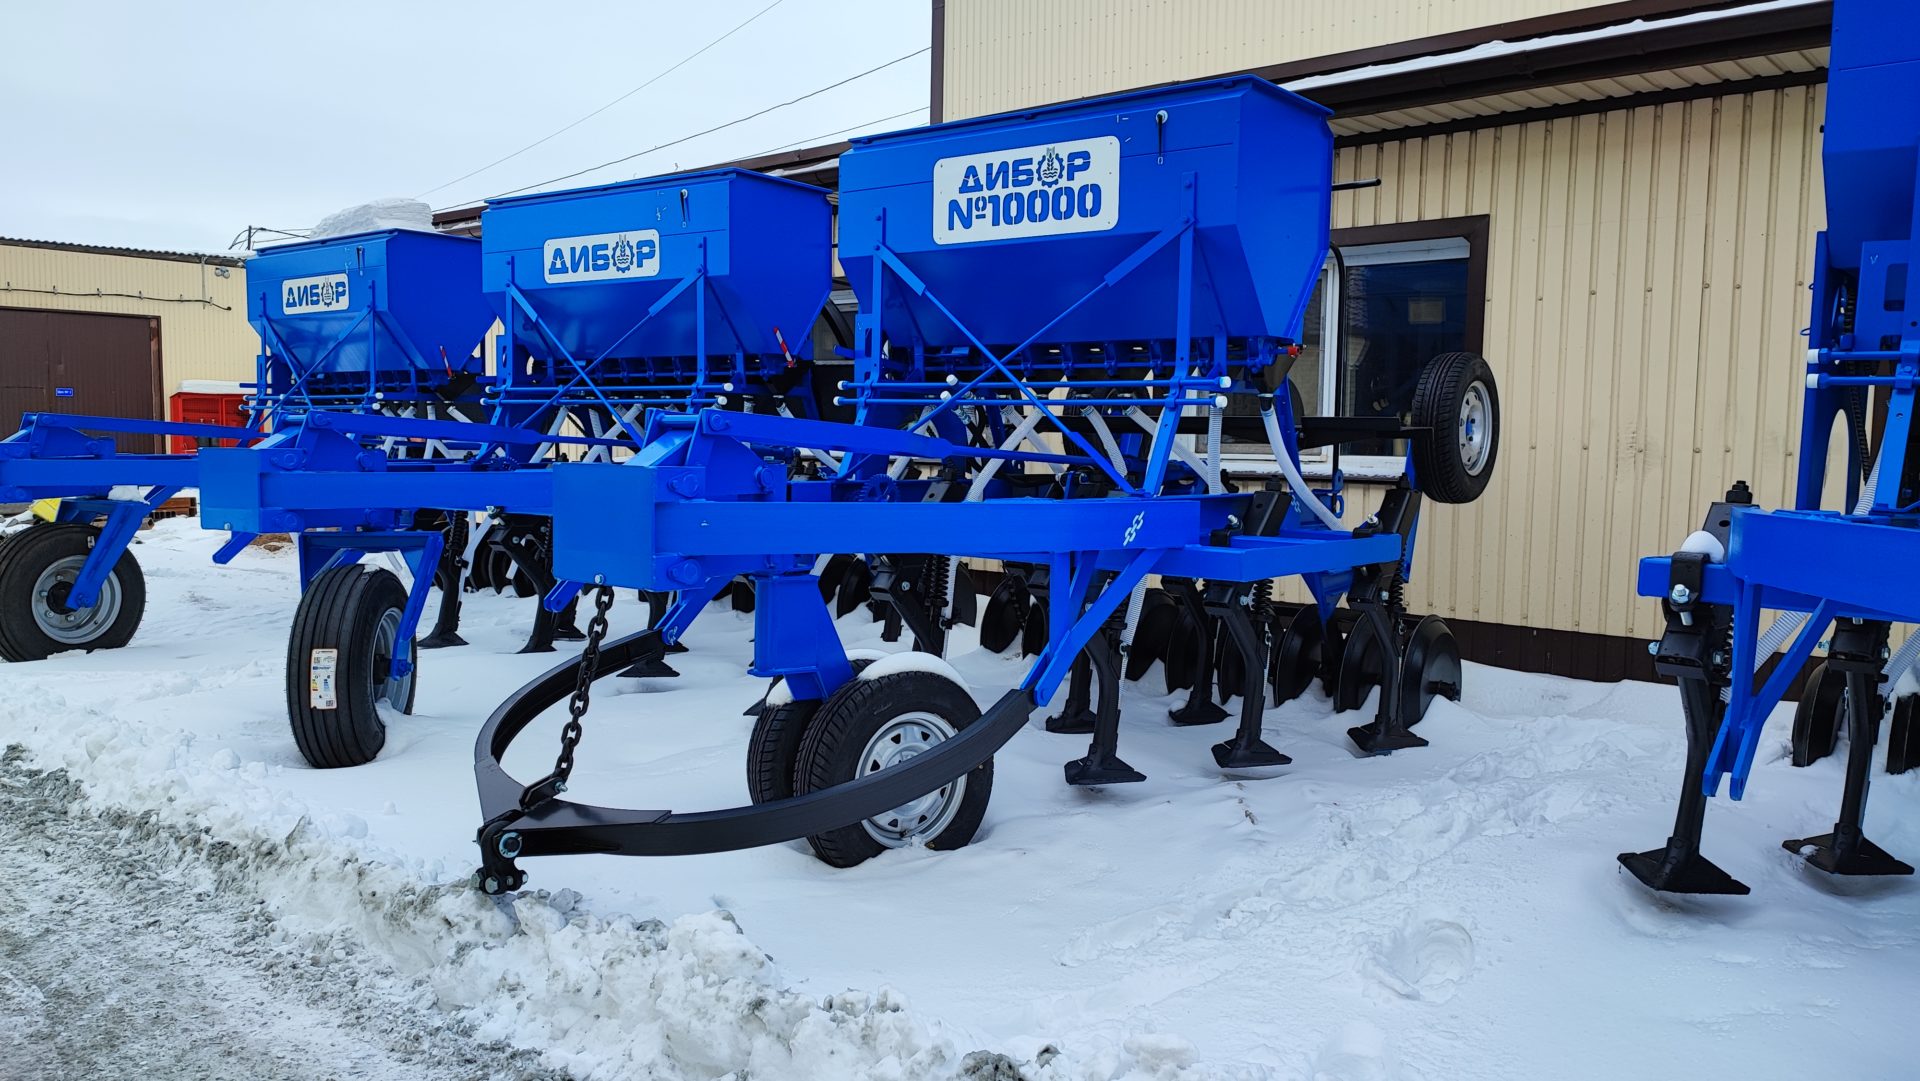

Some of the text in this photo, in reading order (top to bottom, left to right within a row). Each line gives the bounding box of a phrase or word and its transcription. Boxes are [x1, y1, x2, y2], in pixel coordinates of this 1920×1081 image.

[958, 148, 1091, 194] ДИБОР
[548, 236, 656, 275] ДИБОР
[286, 280, 346, 308] ДИБОР
